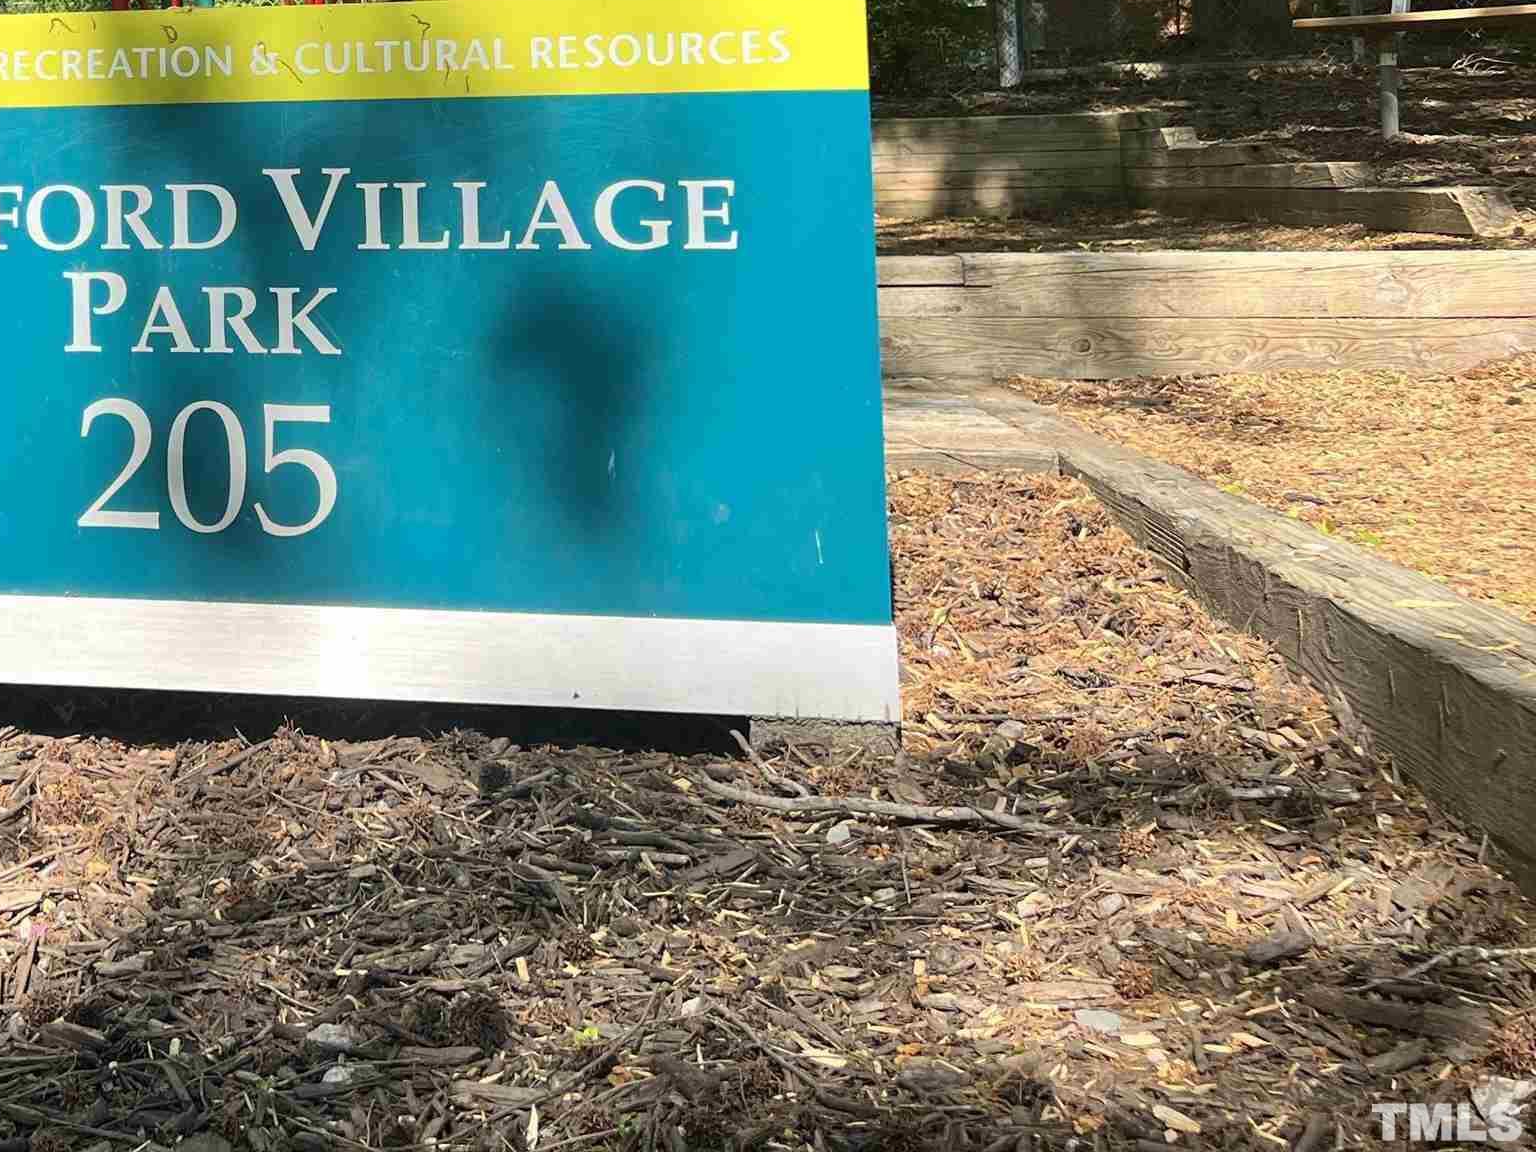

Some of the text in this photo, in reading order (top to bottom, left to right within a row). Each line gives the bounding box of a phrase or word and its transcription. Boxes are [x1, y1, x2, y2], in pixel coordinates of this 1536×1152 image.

[248, 42, 280, 77] &
[294, 38, 513, 76] CULTURAL
[530, 27, 792, 70] RESOURCES
[262, 167, 739, 251] VILLAGE
[63, 267, 341, 355] PARK
[77, 398, 338, 537] 205
